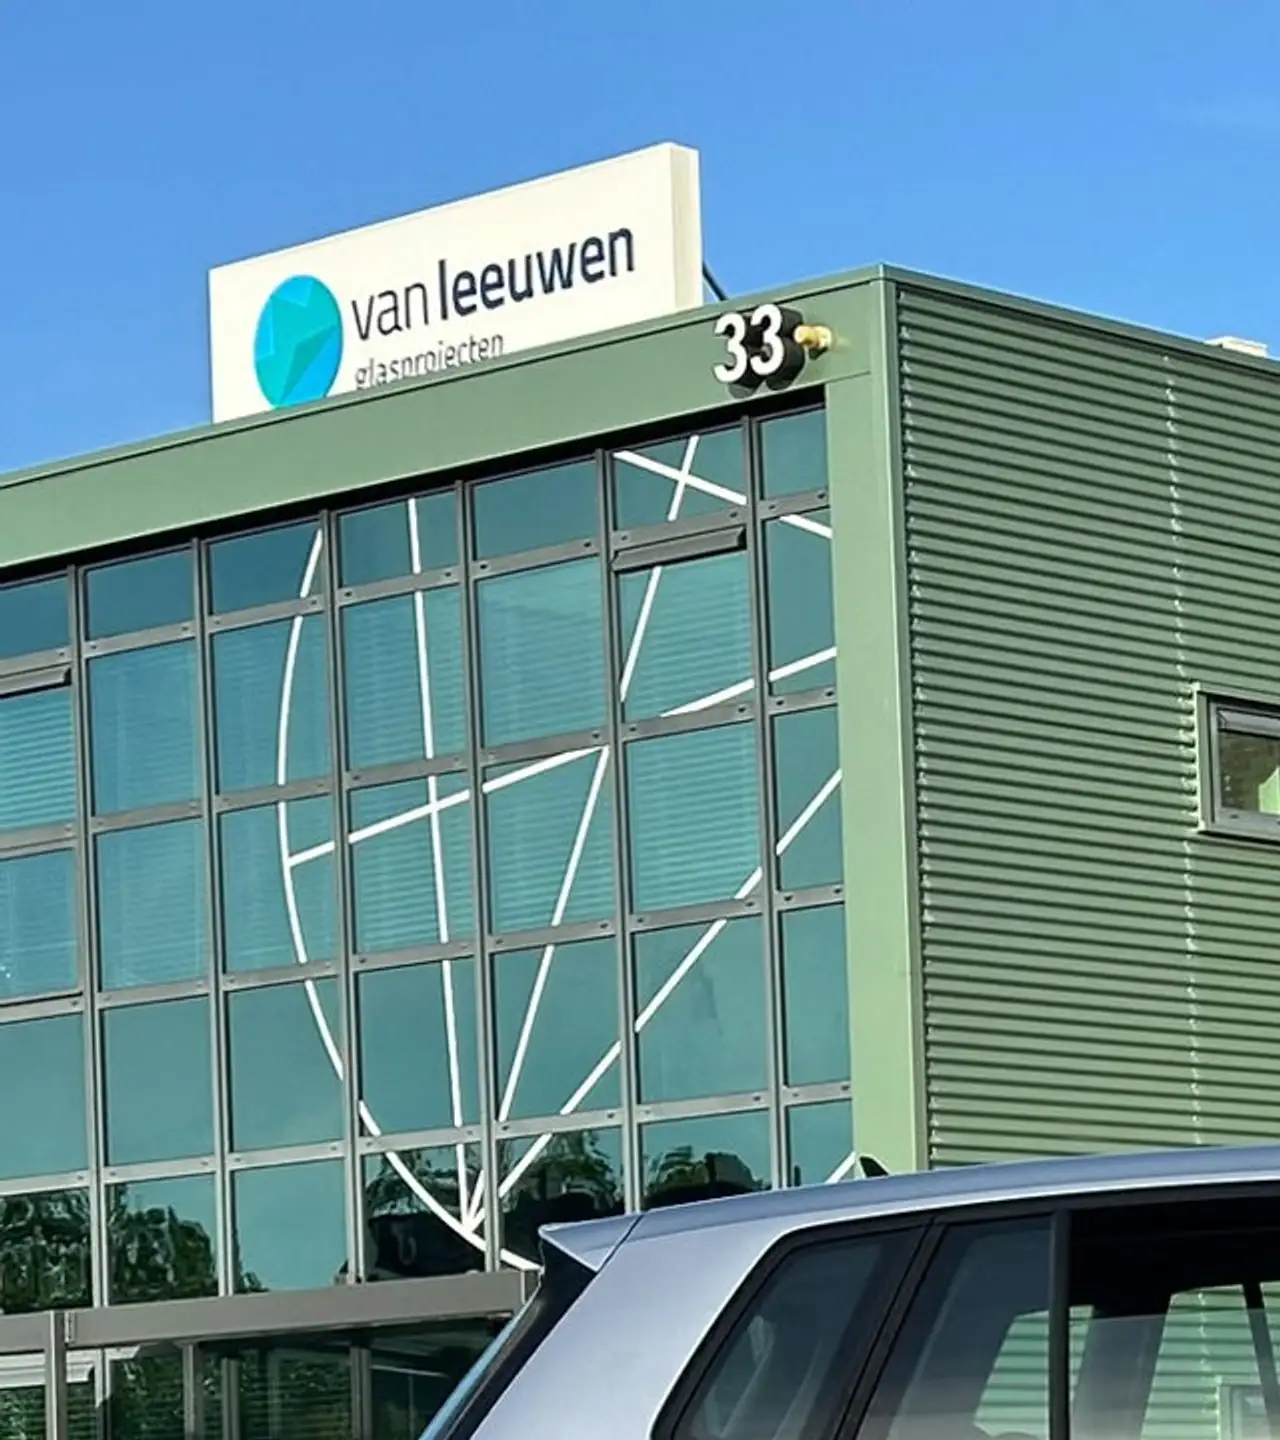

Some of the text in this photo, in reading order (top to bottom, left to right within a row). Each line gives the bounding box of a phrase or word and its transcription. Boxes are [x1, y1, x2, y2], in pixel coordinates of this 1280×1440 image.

[352, 227, 634, 341] van leeuwen
[714, 303, 784, 382] 33
